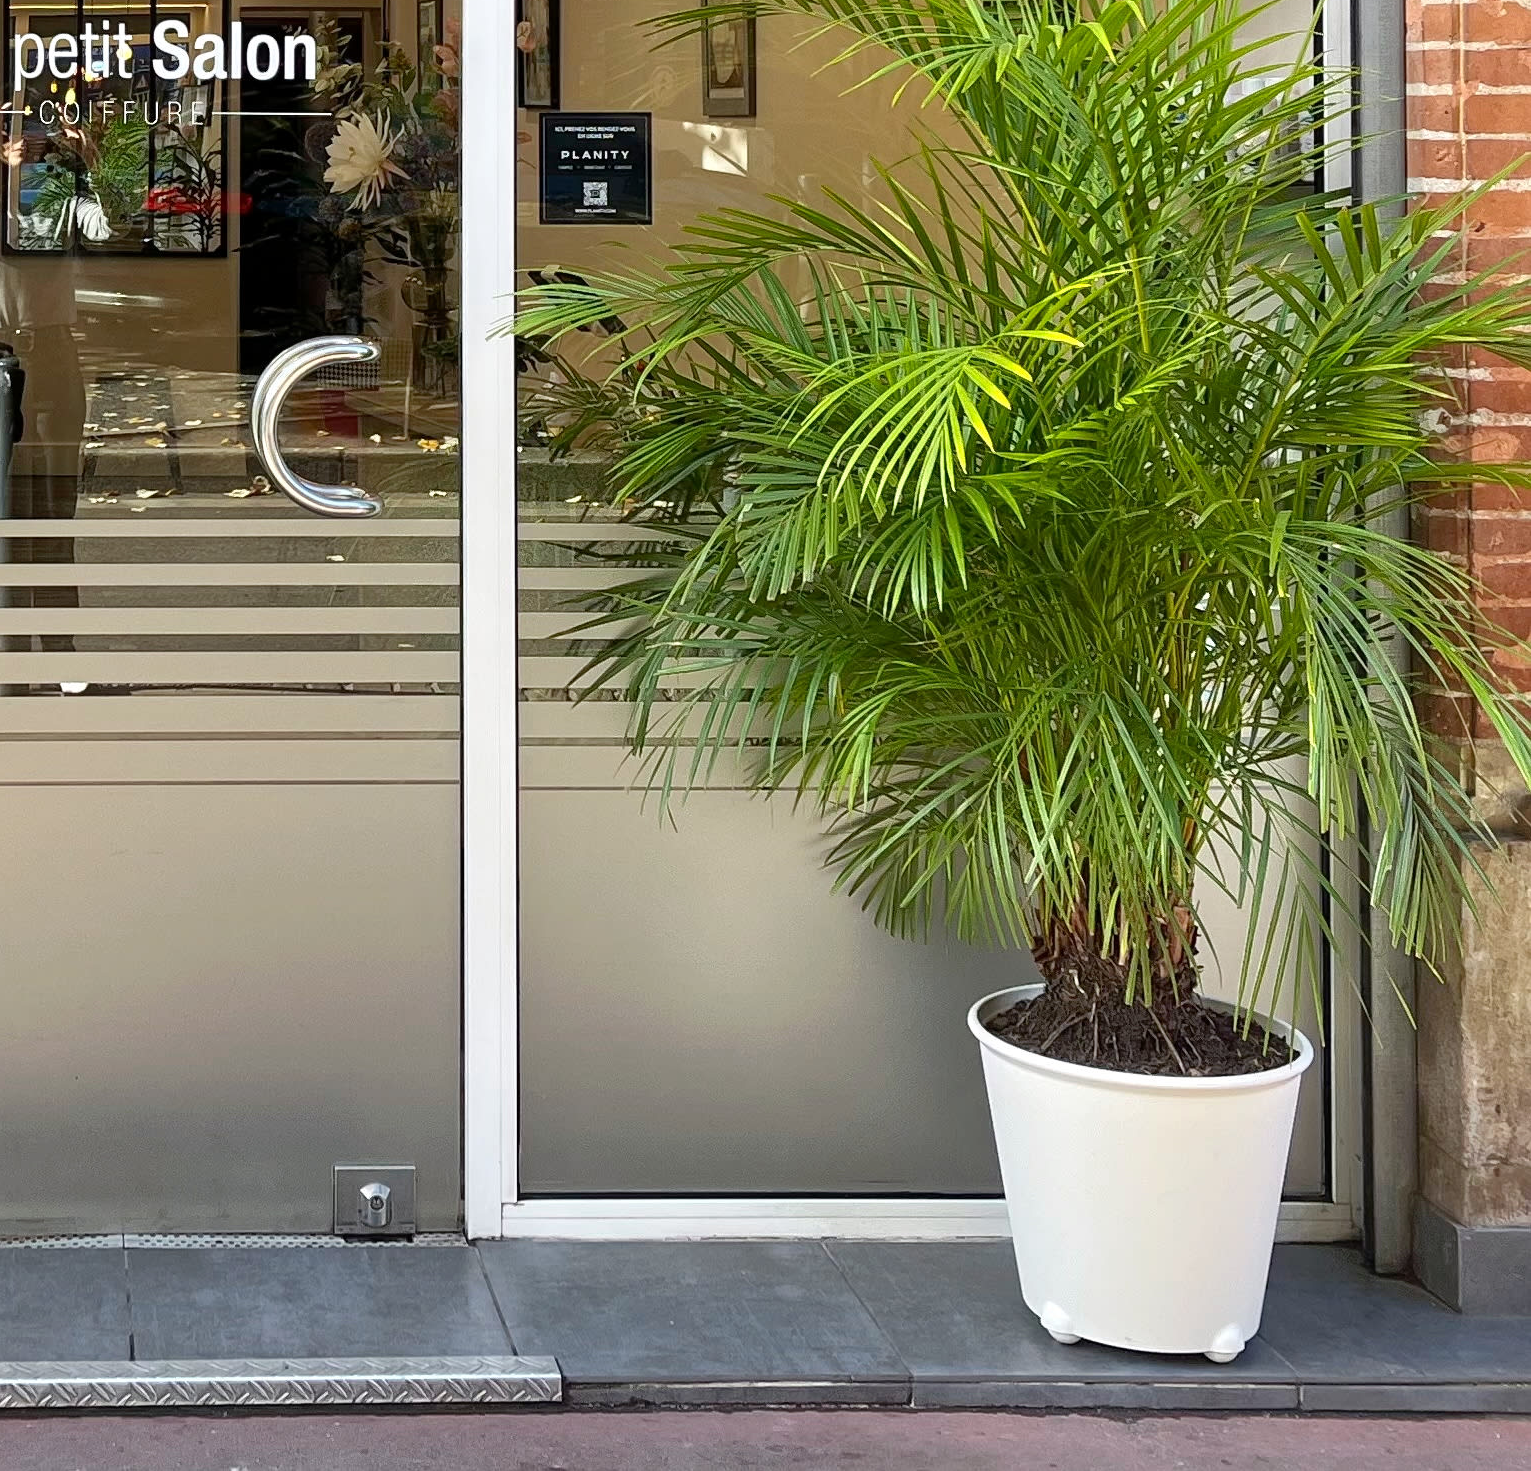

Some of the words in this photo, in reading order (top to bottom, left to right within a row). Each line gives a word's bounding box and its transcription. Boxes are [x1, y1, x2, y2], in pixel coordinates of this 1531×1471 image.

[14, 20, 133, 91] petit
[152, 19, 316, 81] Salon
[39, 99, 204, 126] COIFFURE
[560, 150, 630, 160] PLANITY
